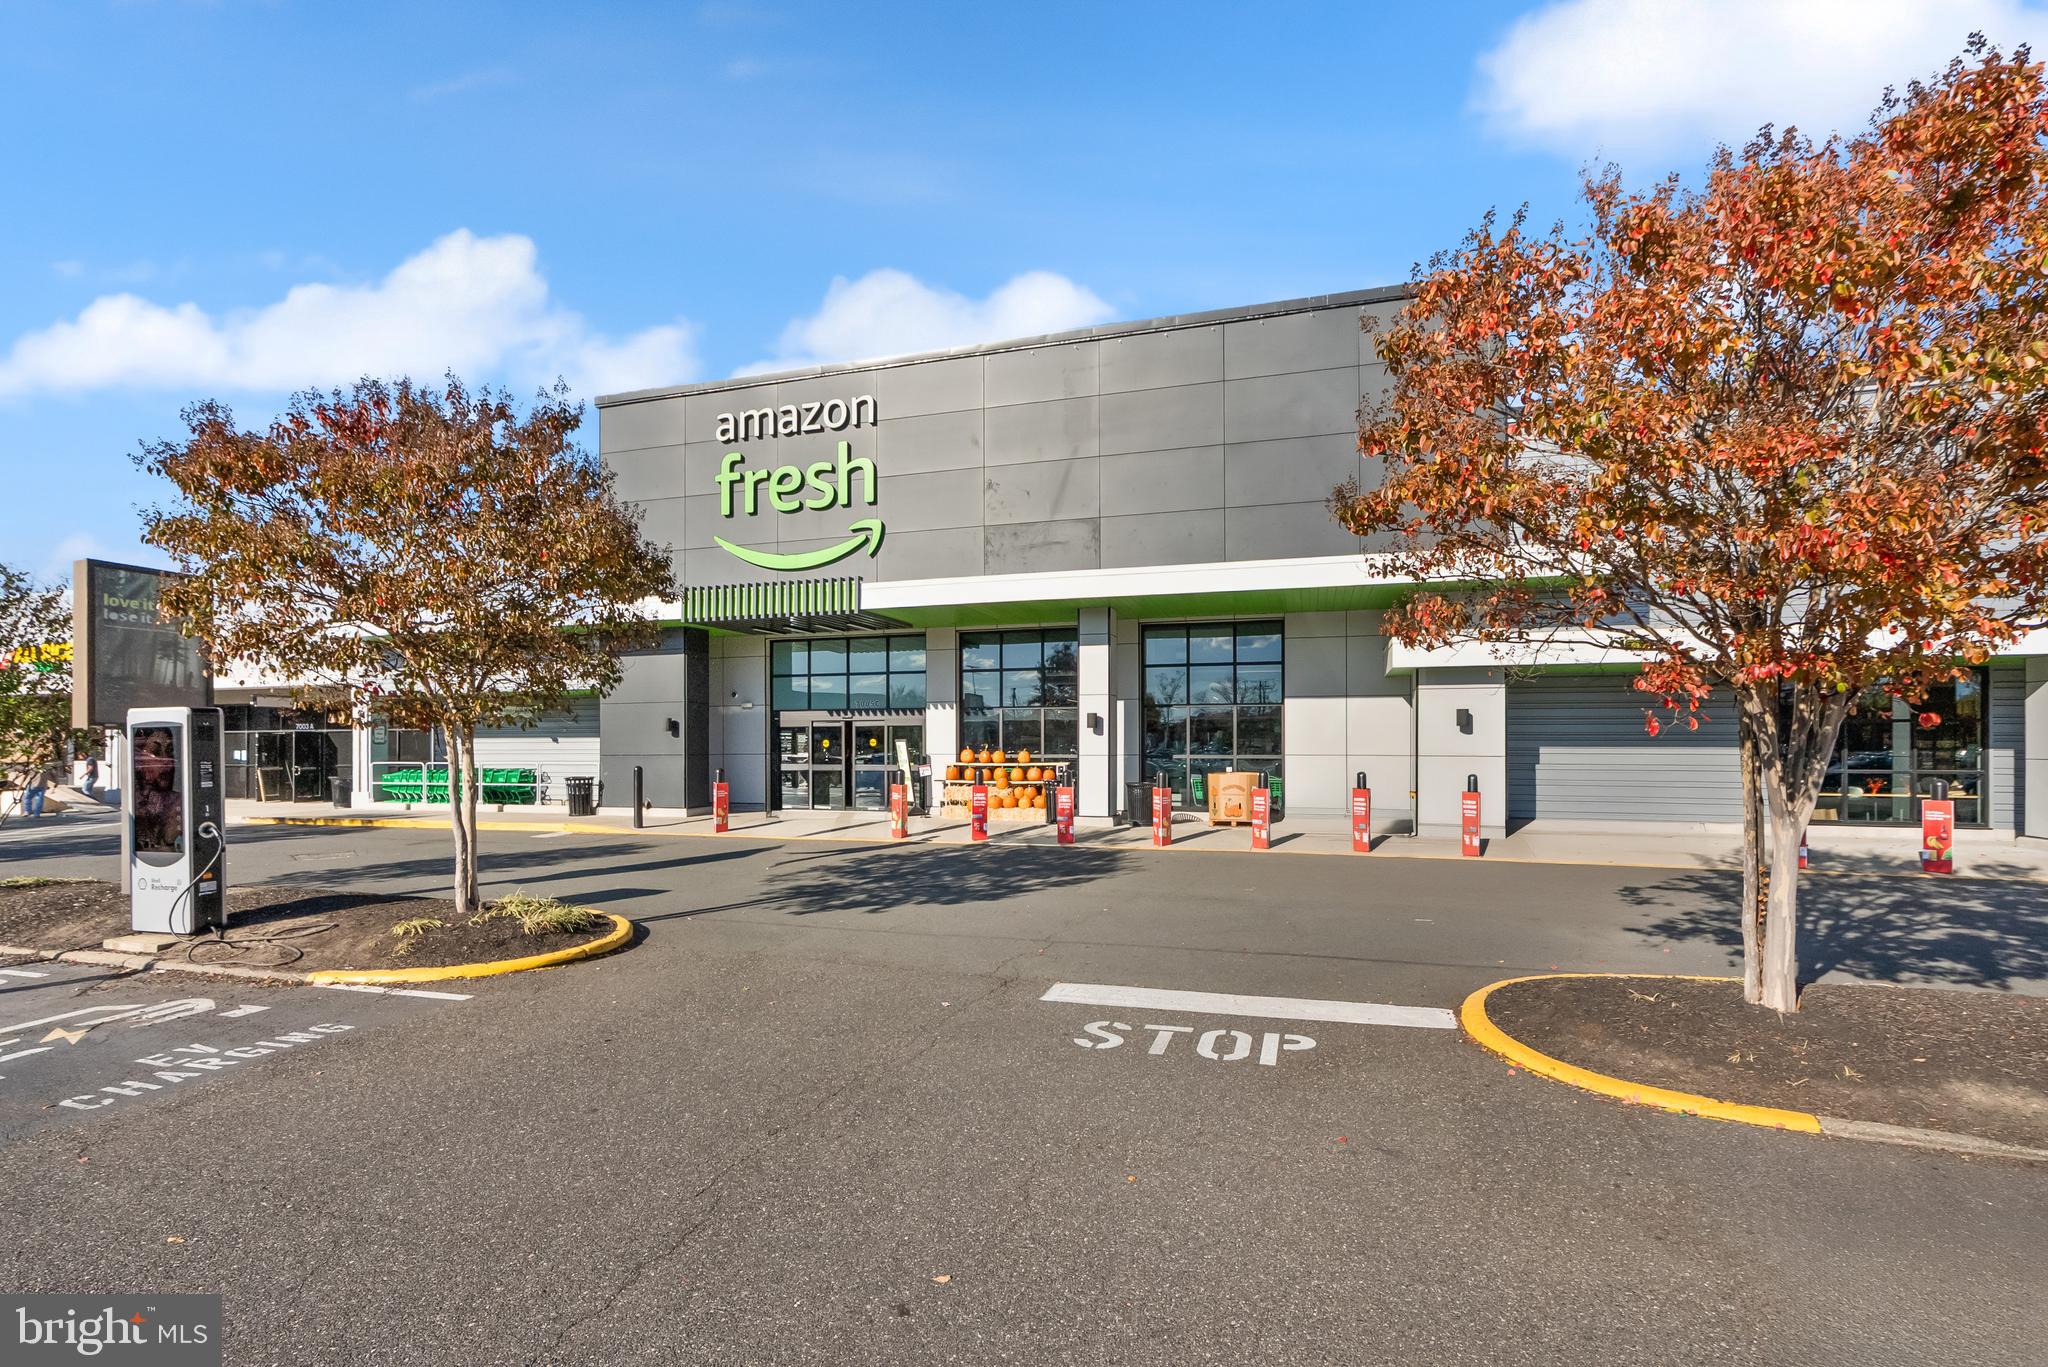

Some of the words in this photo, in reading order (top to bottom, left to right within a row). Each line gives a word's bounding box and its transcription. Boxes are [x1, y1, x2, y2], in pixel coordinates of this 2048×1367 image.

[714, 394, 876, 442] amazon
[714, 440, 876, 516] fresh
[103, 593, 140, 609] love
[143, 598, 155, 611] it
[103, 607, 138, 623] lose
[141, 612, 153, 624] it
[134, 1043, 220, 1067] EV
[1073, 1021, 1317, 1066] STOP
[58, 1023, 356, 1110] CHARGING
